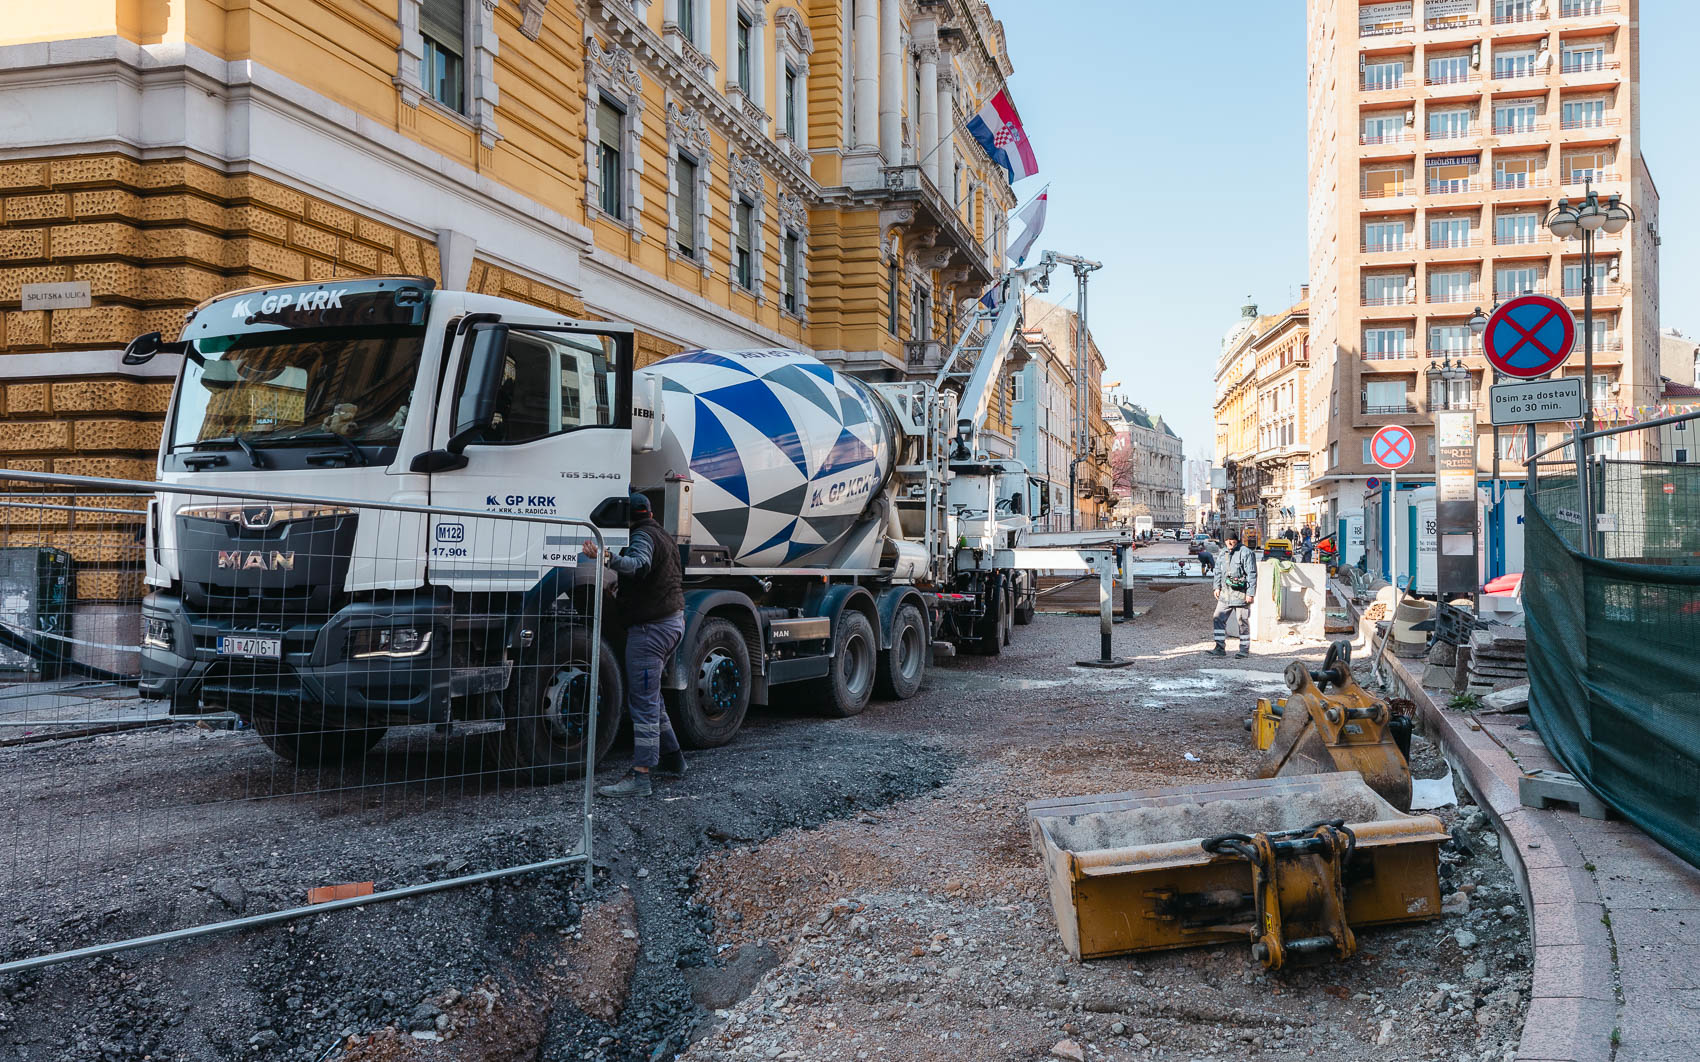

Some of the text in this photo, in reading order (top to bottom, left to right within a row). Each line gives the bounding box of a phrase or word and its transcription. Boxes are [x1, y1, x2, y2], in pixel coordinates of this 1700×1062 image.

[27, 291, 86, 301] SPLITSKA ULICA
[261, 289, 348, 315] GP KRK
[1496, 395, 1519, 403] Osim
[1536, 390, 1577, 400] dostavu
[1510, 402, 1562, 413] do 30 min.
[1112, 437, 1126, 452] A1
[582, 472, 621, 480] 35.440
[829, 481, 846, 502] GP
[847, 474, 872, 498] KRK
[505, 495, 556, 507] GP KRK
[439, 526, 462, 539] M122
[431, 547, 467, 558] 17,90t
[550, 553, 577, 562] GP KRK
[218, 550, 295, 571] MAN
[773, 630, 790, 638] MAN
[224, 639, 278, 655] RI 4716-T
